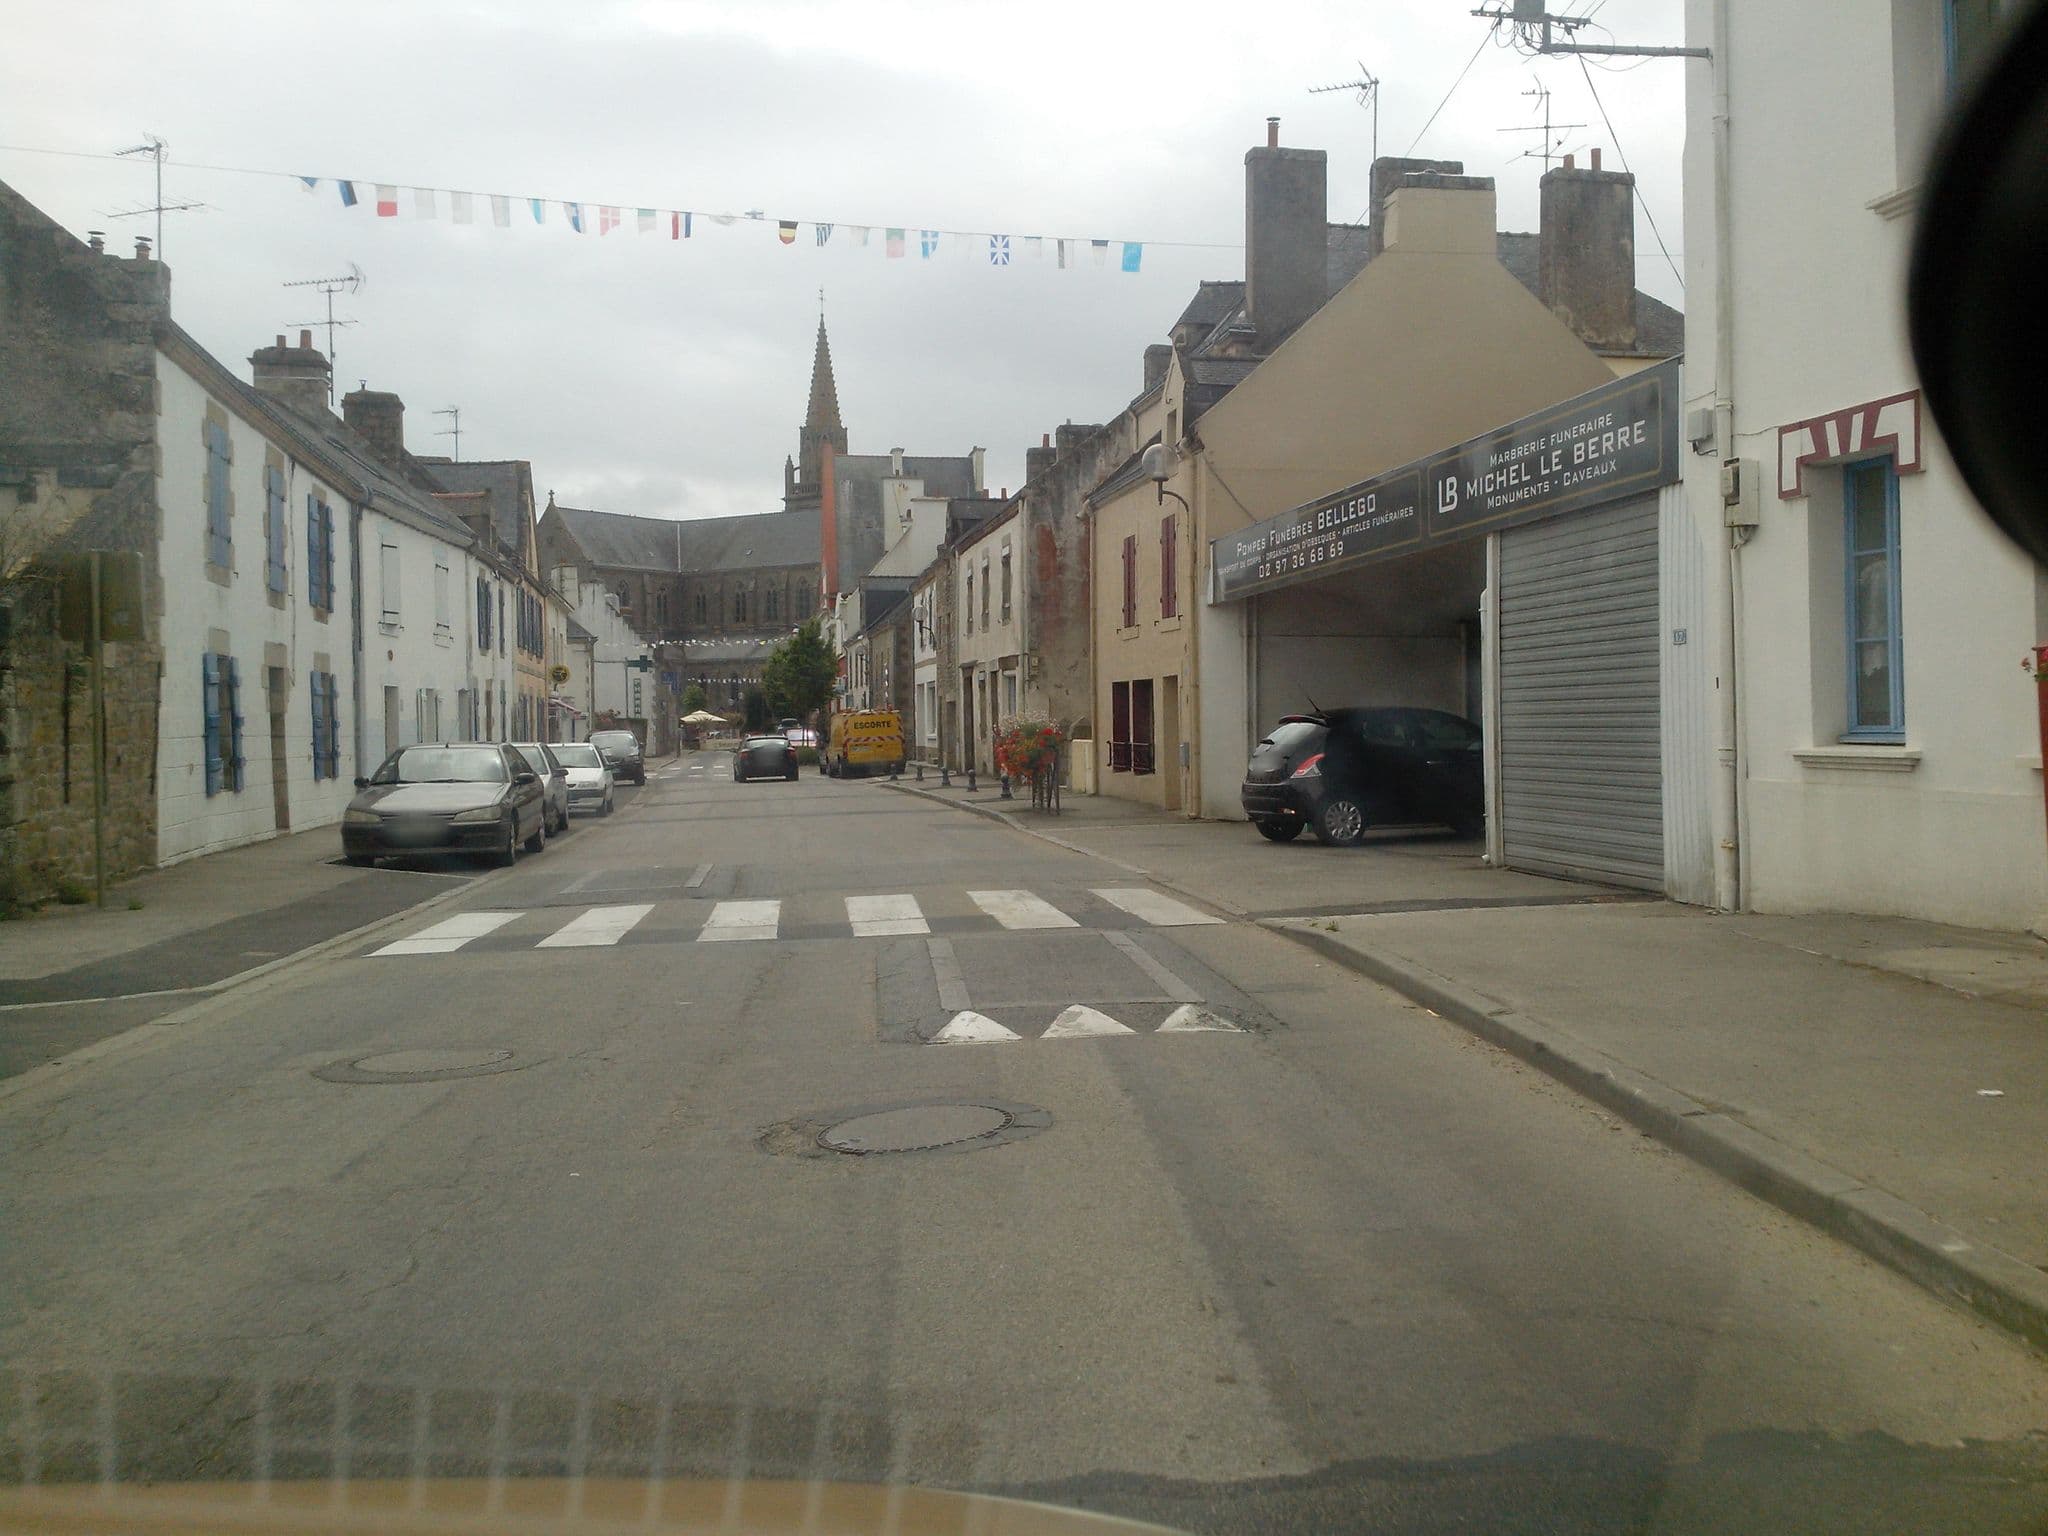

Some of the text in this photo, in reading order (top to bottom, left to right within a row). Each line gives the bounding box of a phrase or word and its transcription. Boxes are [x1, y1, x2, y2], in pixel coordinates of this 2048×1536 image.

[1466, 420, 1646, 500] MICHEL LE BERRE
[1489, 437, 1546, 467] MARBRERIE
[1487, 459, 1617, 510] MONUMENTS CAVEAUX
[1236, 538, 1266, 557] POMPES
[1317, 493, 1377, 530] BELLEGO
[1342, 519, 1371, 537] ARTICLES
[1259, 563, 1271, 579] 02
[1275, 558, 1287, 573] 97
[1292, 552, 1305, 569] 36
[1310, 547, 1324, 563] 68
[1330, 541, 1344, 558] 69
[853, 720, 892, 730] ESCORTE
